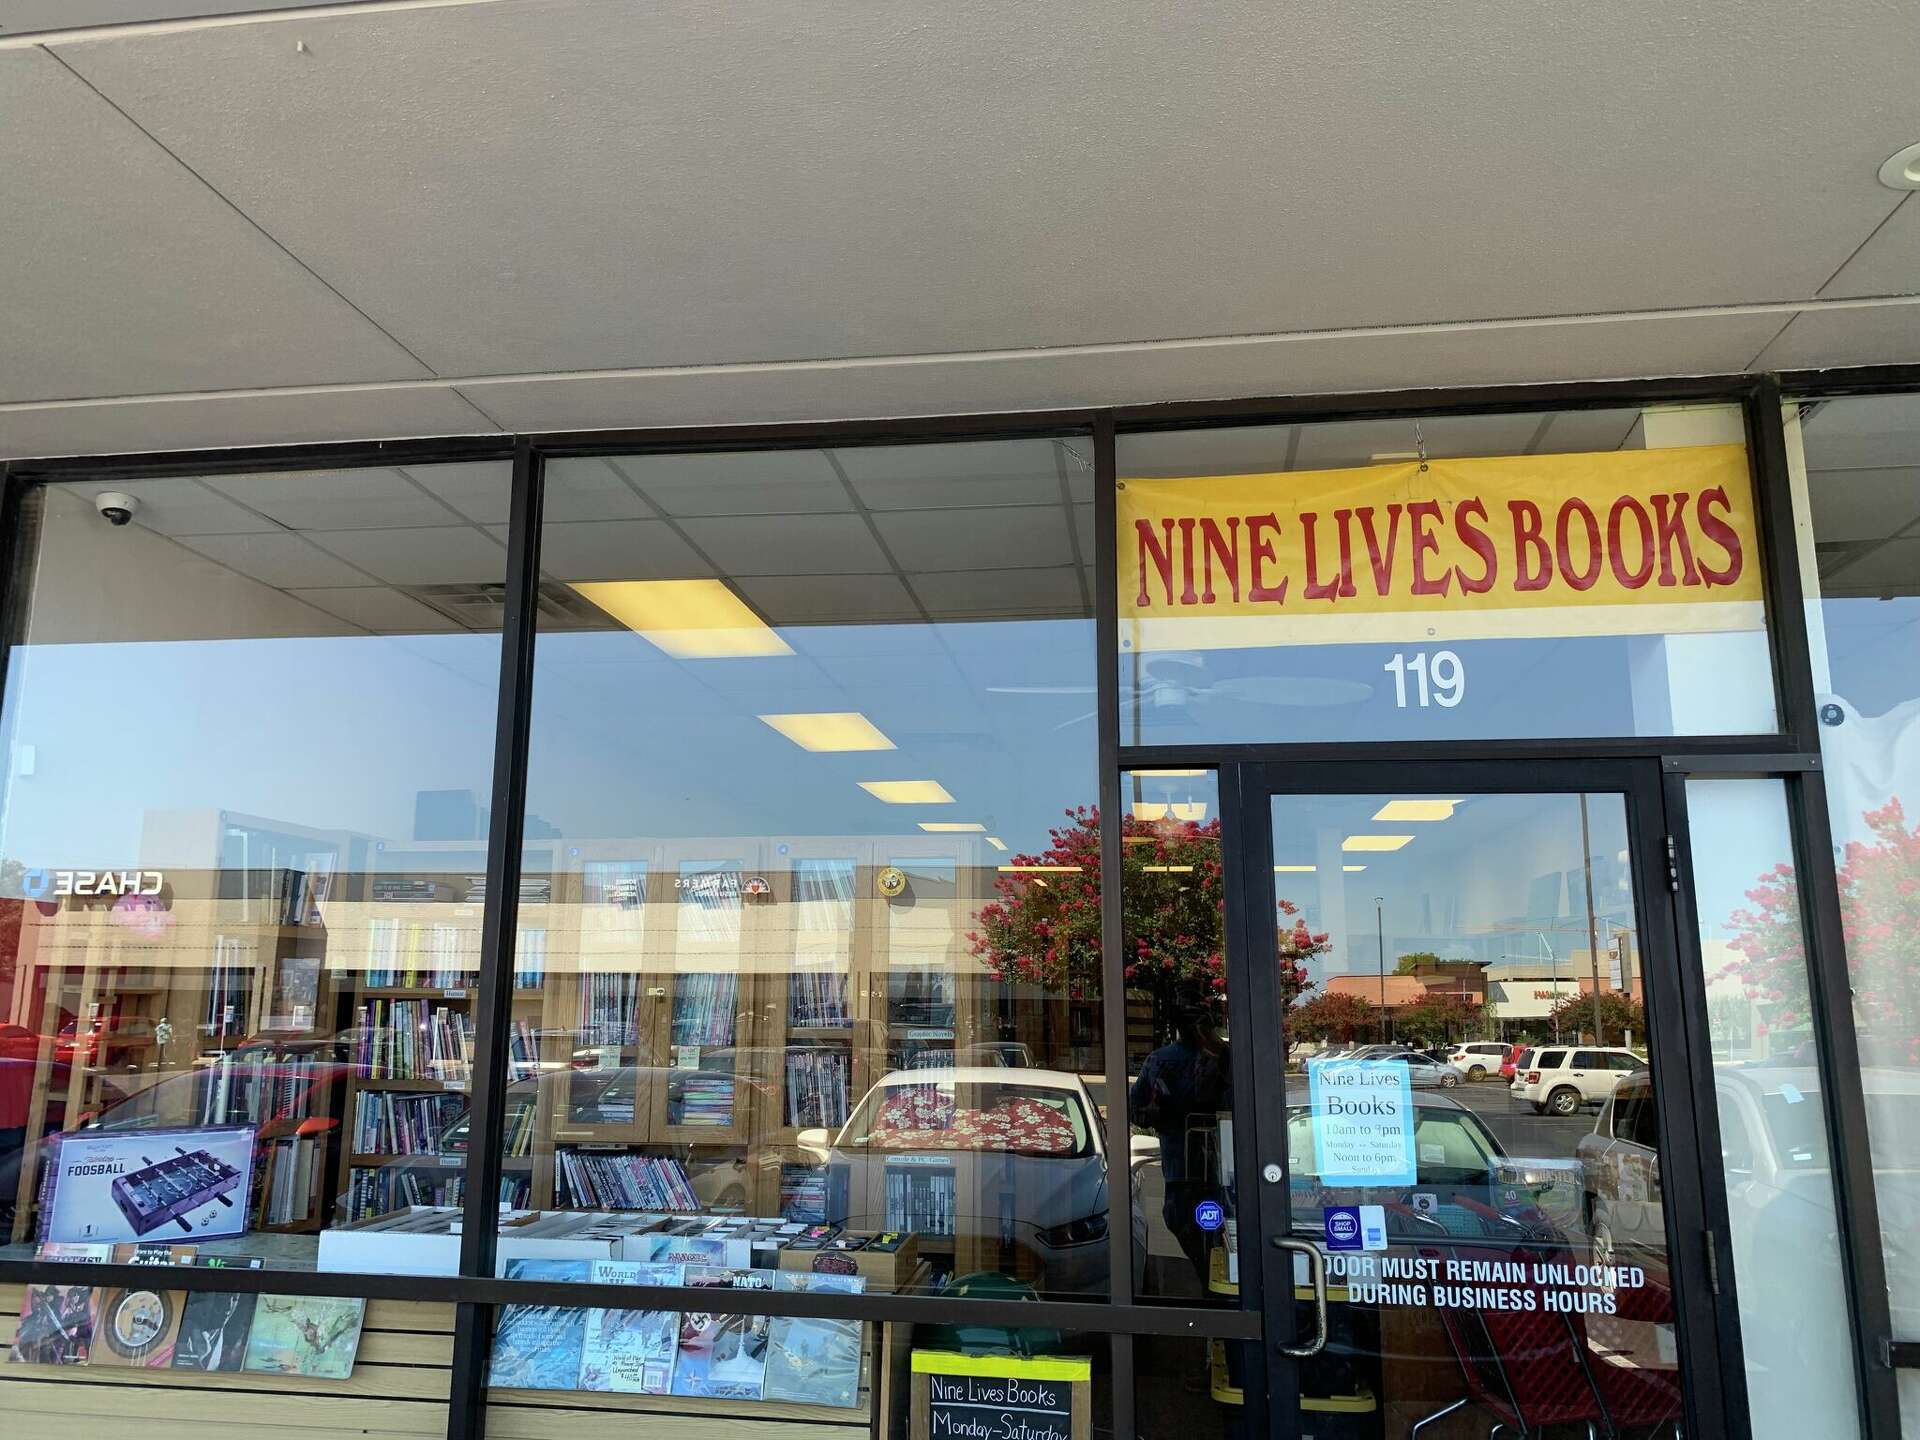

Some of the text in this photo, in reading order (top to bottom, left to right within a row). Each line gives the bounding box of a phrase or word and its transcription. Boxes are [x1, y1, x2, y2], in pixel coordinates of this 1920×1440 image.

[1134, 484, 1744, 607] NINE LIVES BOOKS
[1384, 649, 1465, 708] 119
[1319, 1072, 1400, 1086] Nine Lives
[1327, 1095, 1396, 1115] Books
[1360, 1125, 1371, 1135] to
[1333, 1153, 1360, 1162] Noon
[1362, 1153, 1372, 1162] to
[67, 1163, 126, 1177] FOOSBALL
[1201, 1210, 1219, 1221] ADT
[599, 1266, 637, 1279] WORLD
[1382, 1257, 1439, 1280] MUST
[1446, 1260, 1527, 1283] REMAIN
[1533, 1263, 1645, 1288] UNLOCKED
[733, 1276, 764, 1288] NATO
[1349, 1282, 1616, 1314] DURING BUSINESS HOURS
[931, 1375, 1056, 1406] Nine Lives Books
